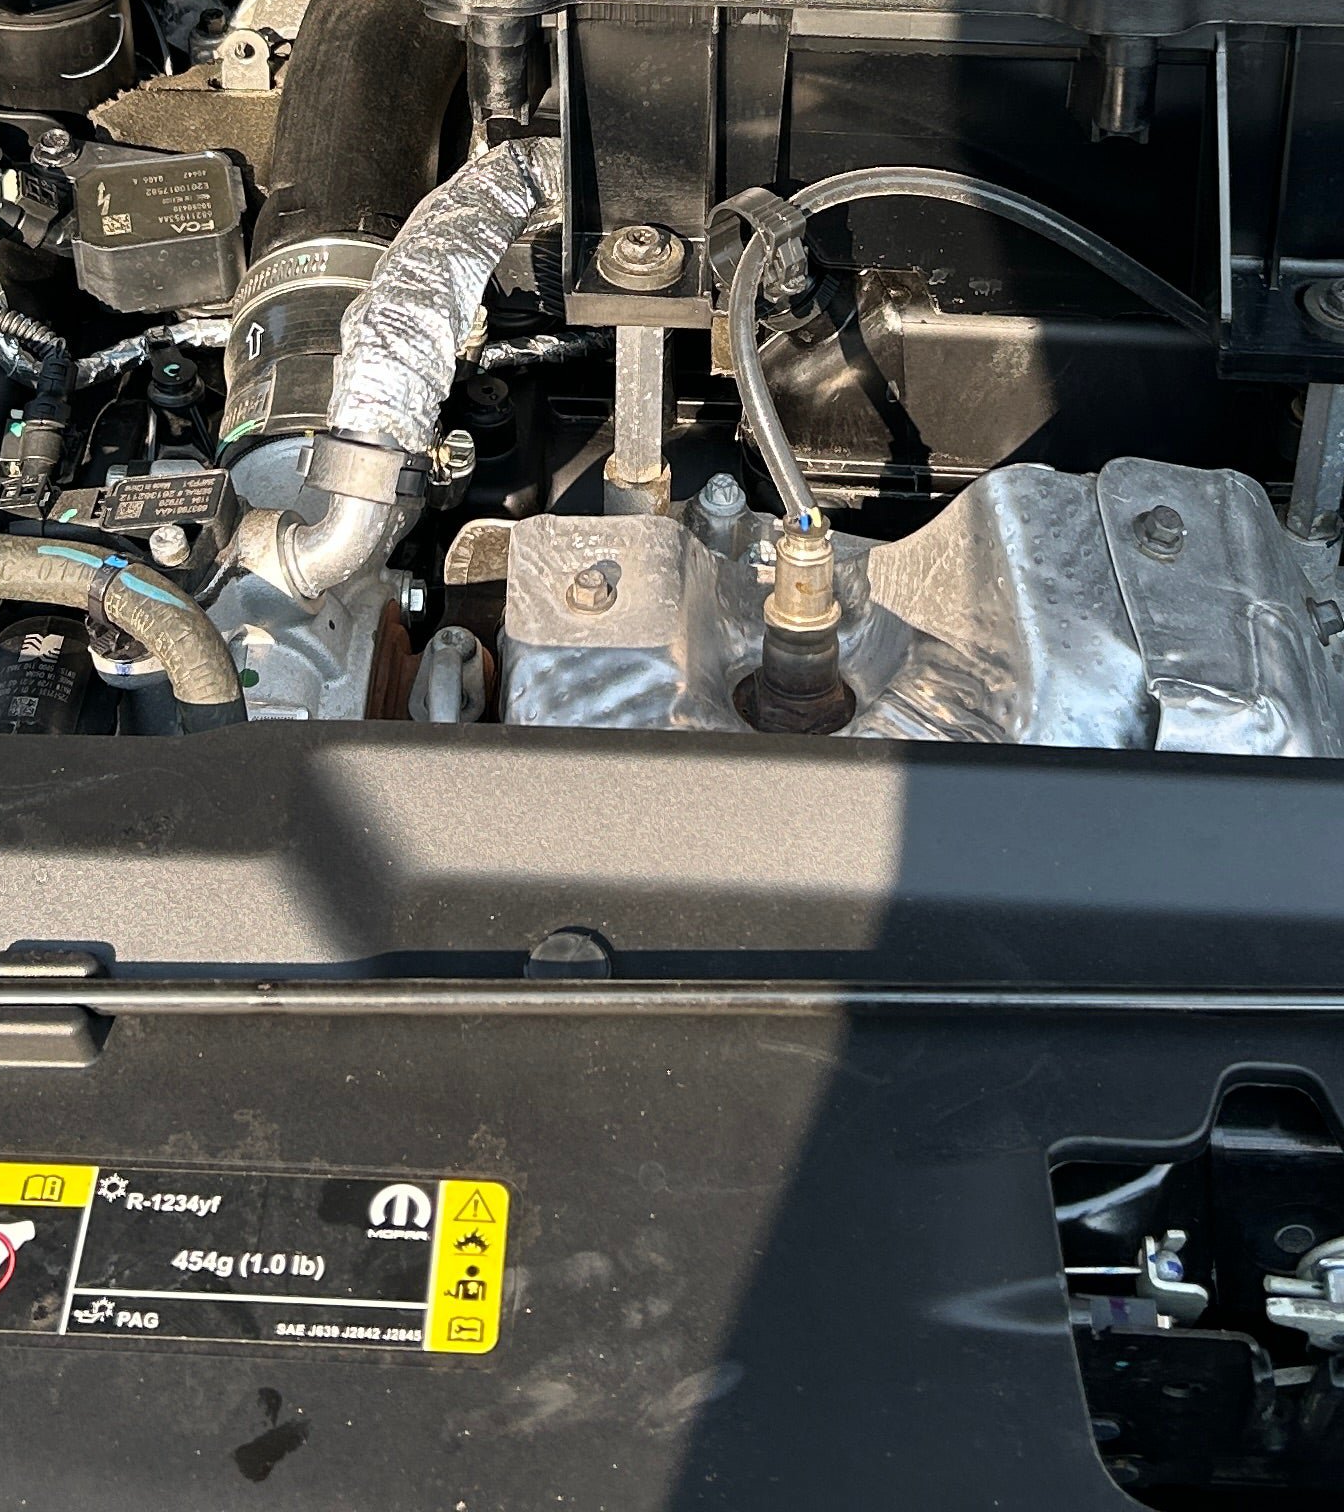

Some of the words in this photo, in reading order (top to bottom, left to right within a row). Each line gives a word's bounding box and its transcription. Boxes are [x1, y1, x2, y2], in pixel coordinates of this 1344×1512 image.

[170, 219, 215, 234] FCA
[125, 1192, 222, 1216] R-1234yf
[170, 1249, 234, 1277] 454g
[239, 1253, 286, 1278] (1.0
[291, 1255, 325, 1281] lb)
[116, 1310, 159, 1329] PAG
[275, 1322, 305, 1336] SAE
[308, 1324, 340, 1338] J639
[341, 1326, 380, 1340] J2842
[382, 1328, 422, 1342] J2845
